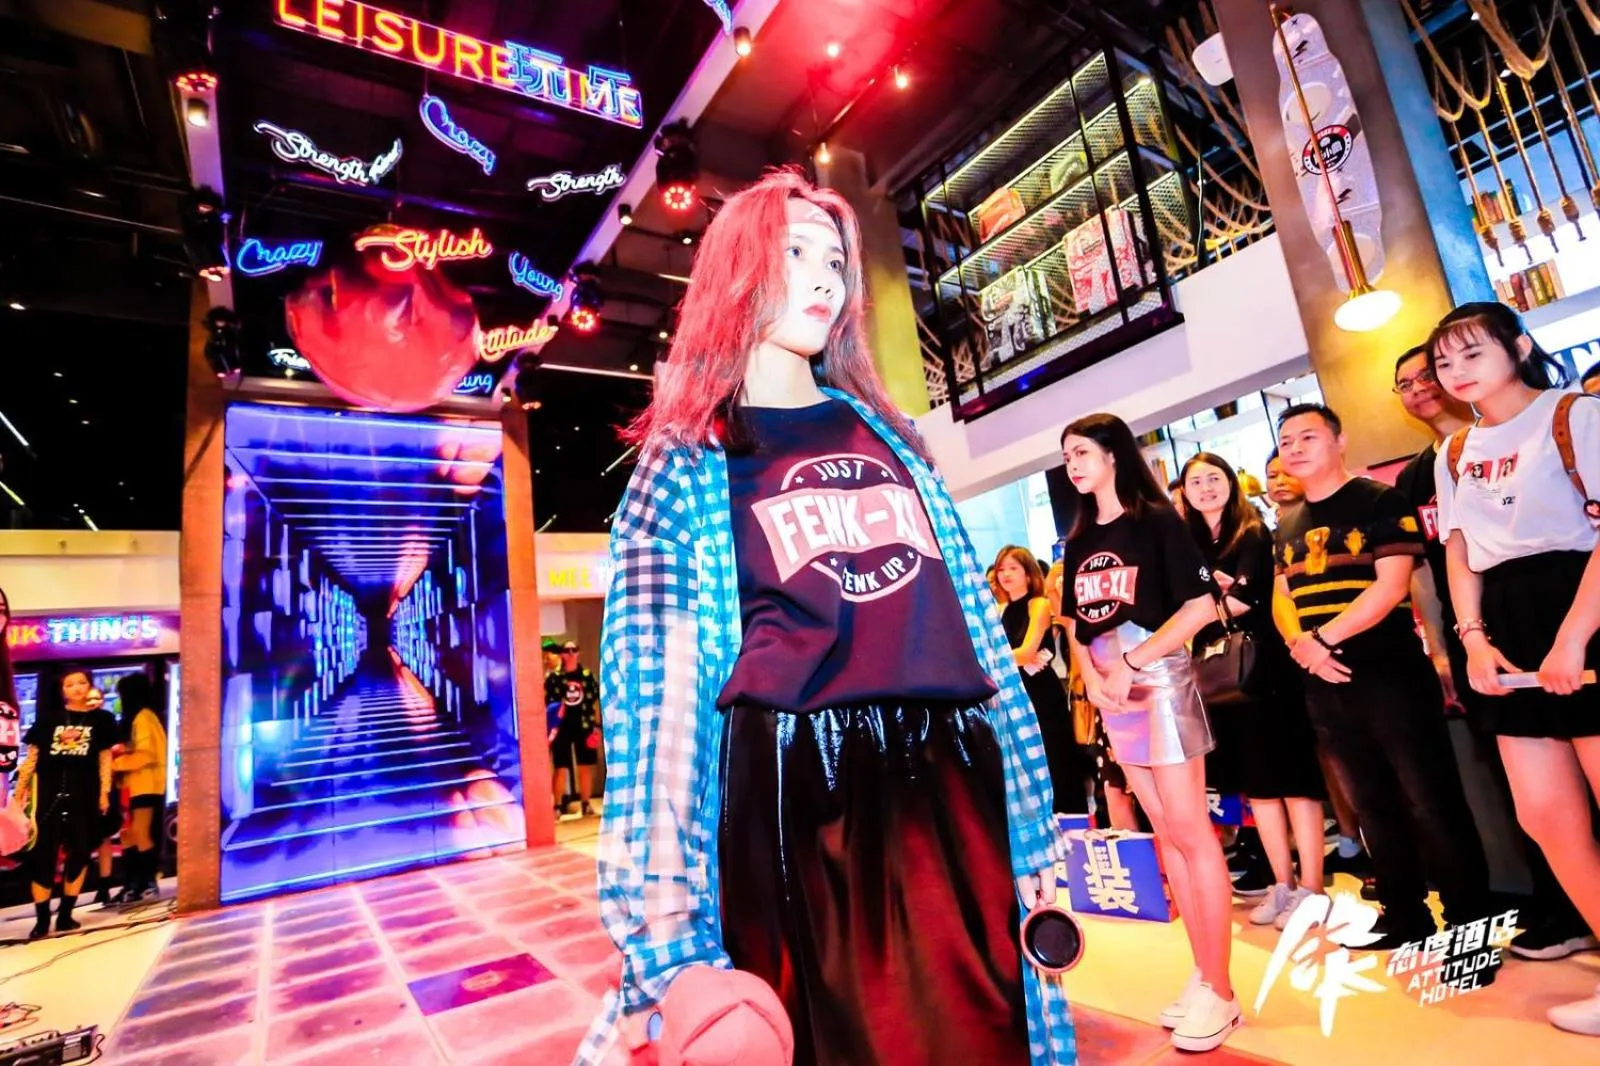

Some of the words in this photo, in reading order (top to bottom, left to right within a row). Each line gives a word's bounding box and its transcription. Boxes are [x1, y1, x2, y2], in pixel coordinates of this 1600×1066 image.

[278, 0, 514, 85] LEISURE
[253, 120, 369, 184] Strength
[526, 164, 626, 200] Strength
[236, 237, 323, 276] Crazy
[355, 228, 493, 272] Stylish
[508, 251, 564, 302] Young
[812, 459, 865, 482] JUST
[767, 489, 929, 565] FENK-XL
[881, 556, 907, 580] UP
[1076, 569, 1130, 604] ENK-XL
[48, 615, 159, 644] THINGS
